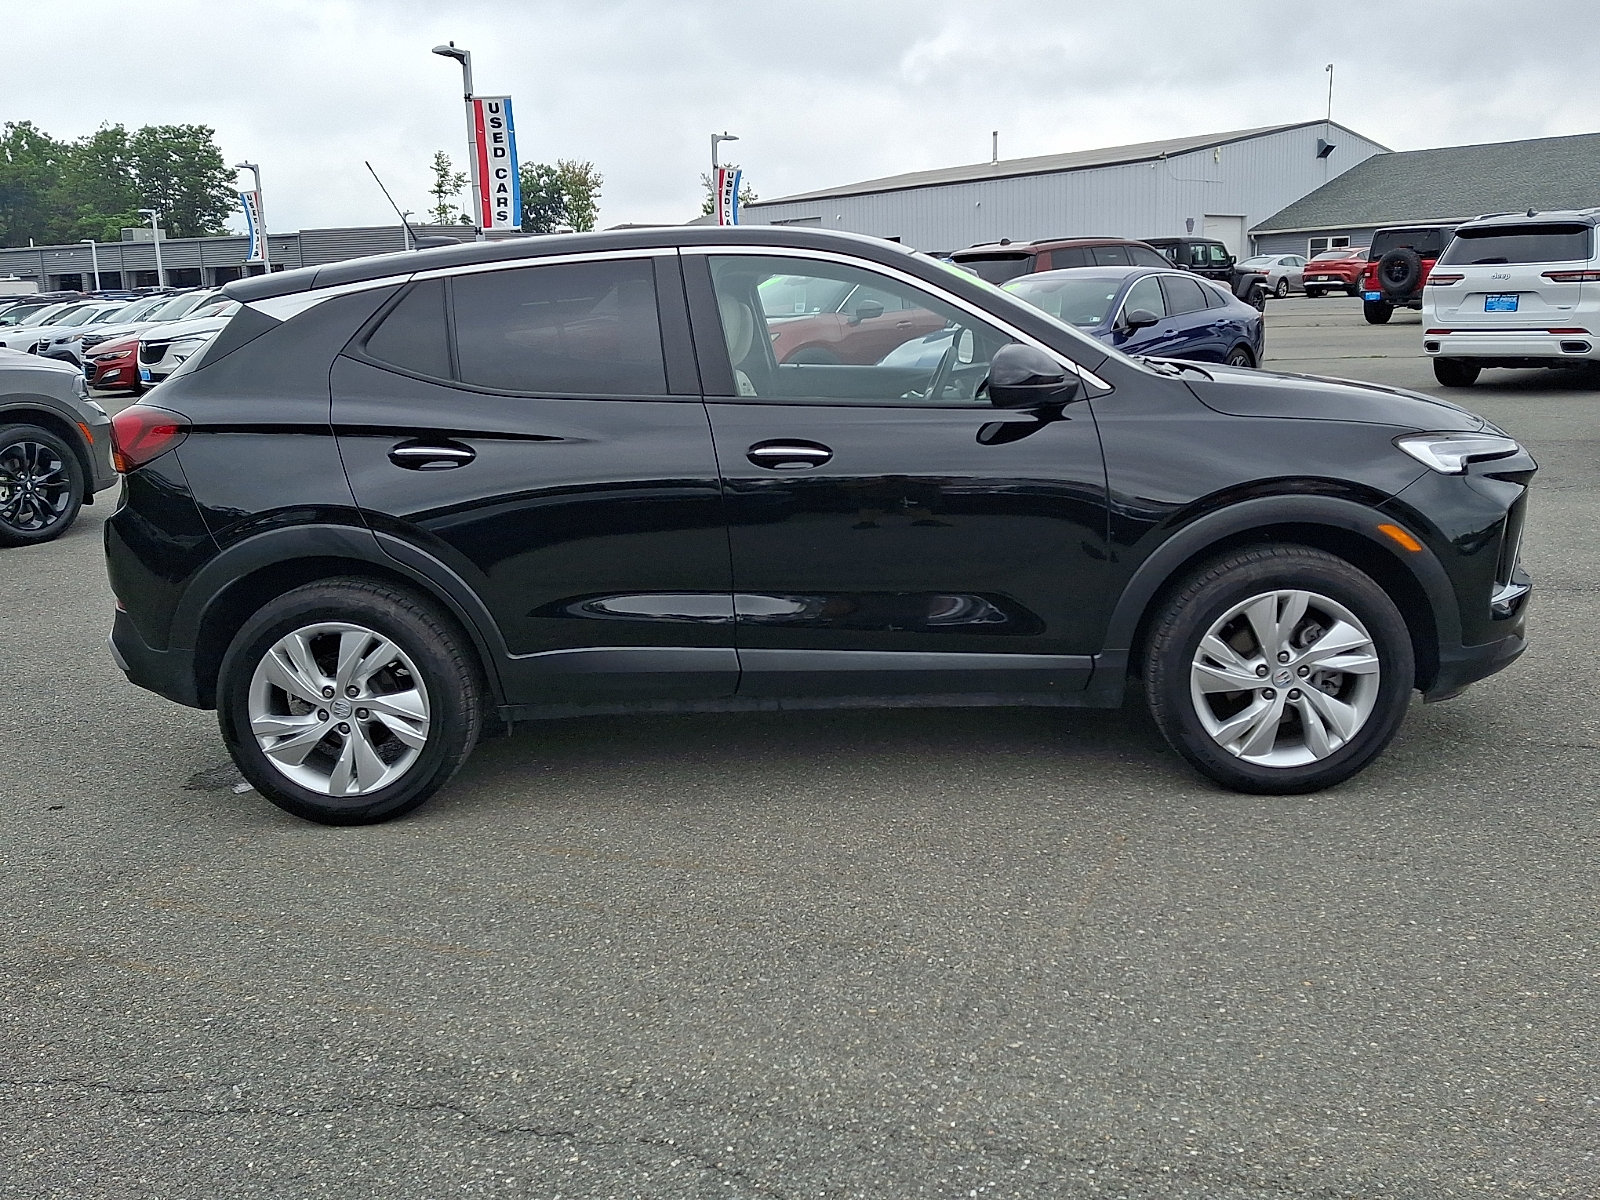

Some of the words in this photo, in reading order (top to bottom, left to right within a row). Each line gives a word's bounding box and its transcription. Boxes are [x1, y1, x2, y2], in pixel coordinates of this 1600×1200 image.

[488, 102, 506, 158] USED
[494, 168, 509, 221] CARS
[725, 171, 734, 205] USED
[1490, 271, 1512, 281] Jeep
